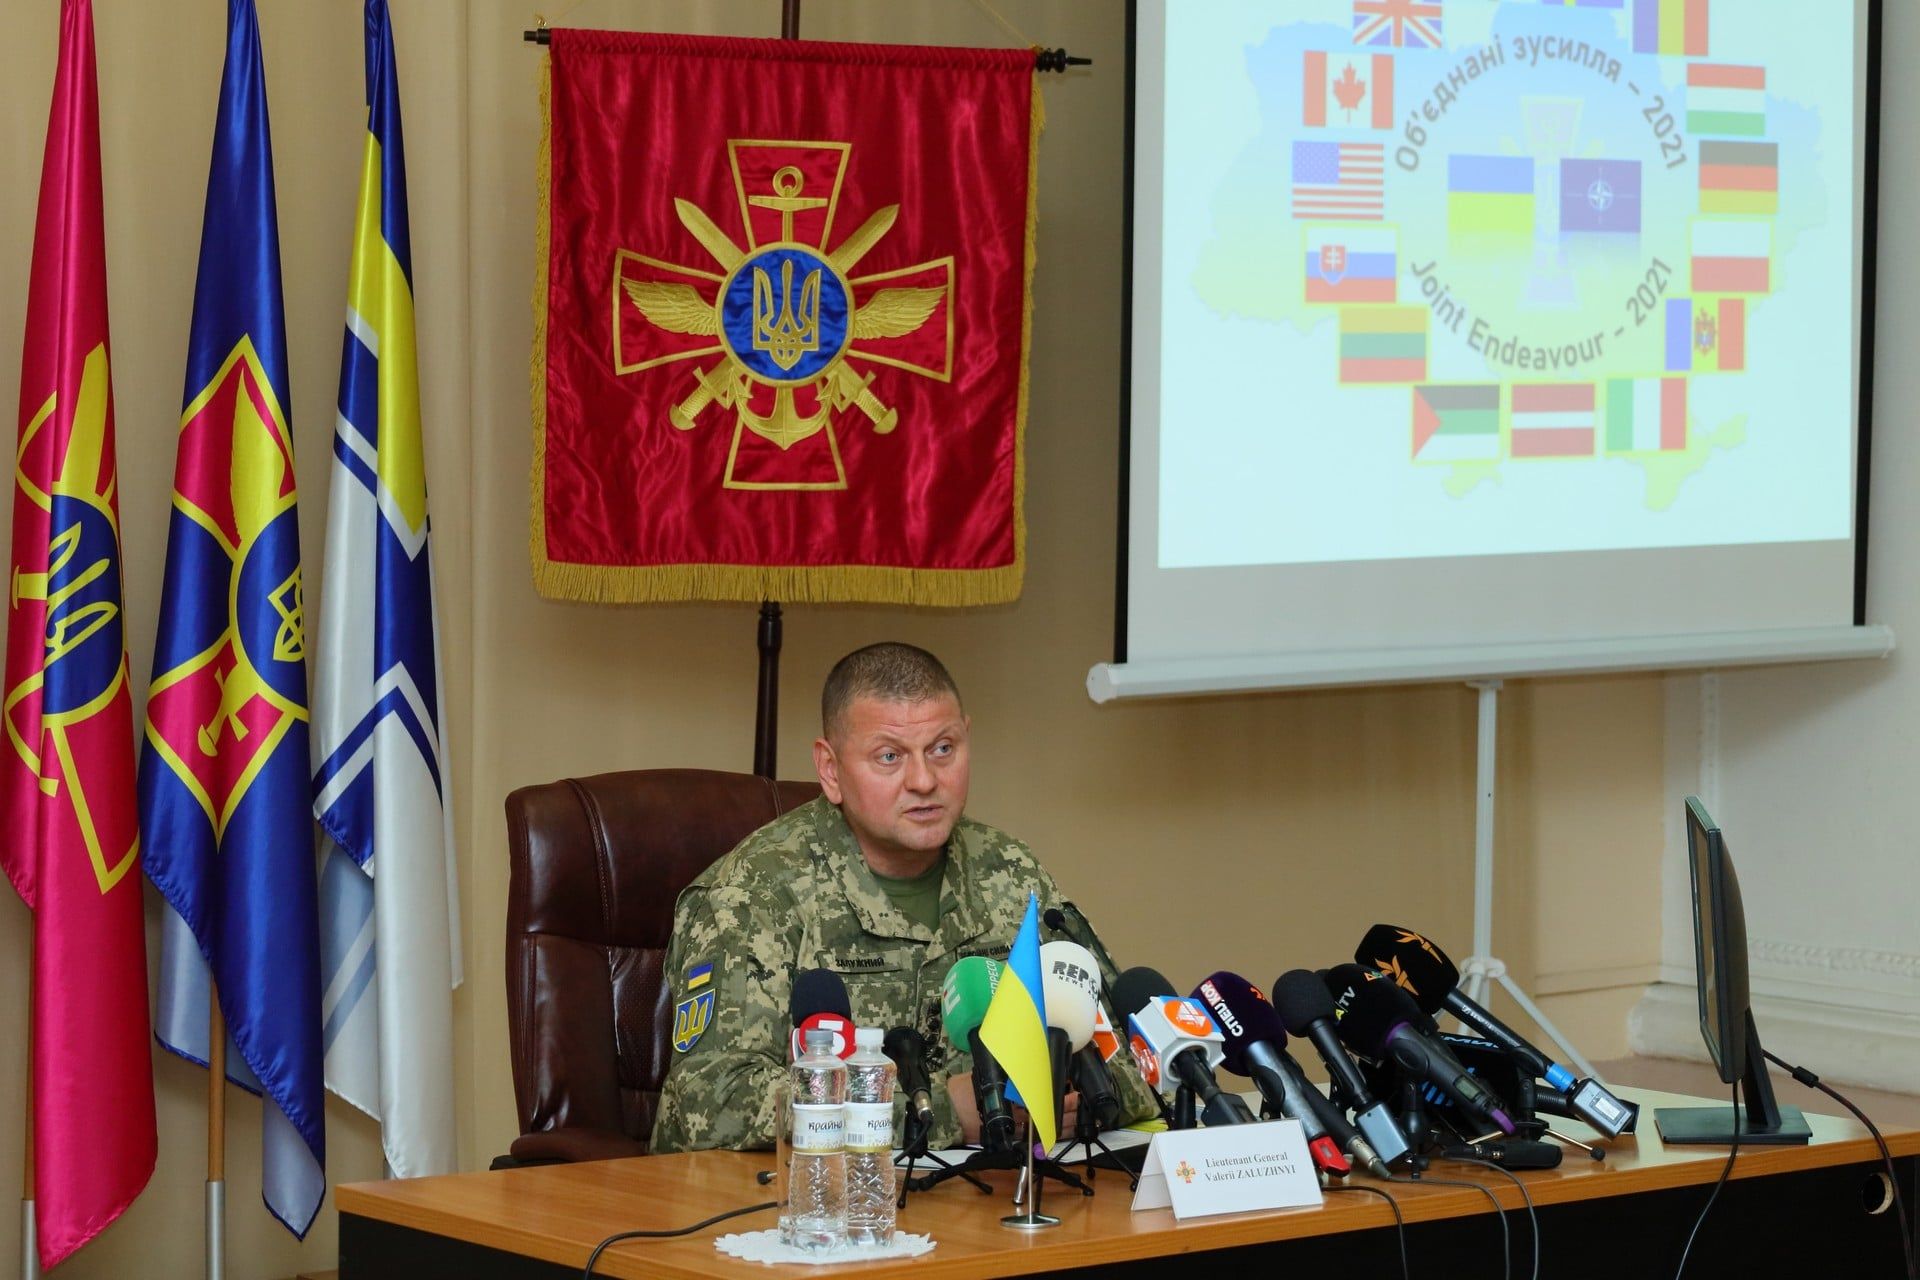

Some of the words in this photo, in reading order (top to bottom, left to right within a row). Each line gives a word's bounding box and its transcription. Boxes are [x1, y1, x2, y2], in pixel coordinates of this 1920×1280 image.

[1512, 35, 1622, 84] зусилля
[1642, 95, 1687, 169] 2021
[1411, 260, 1466, 334] Joint
[1466, 317, 1604, 370] Endeavour
[1625, 256, 1673, 326] 2021
[1204, 1169, 1236, 1182] Valerii
[1205, 1156, 1252, 1168] Lieutenant
[1253, 1152, 1288, 1164] General
